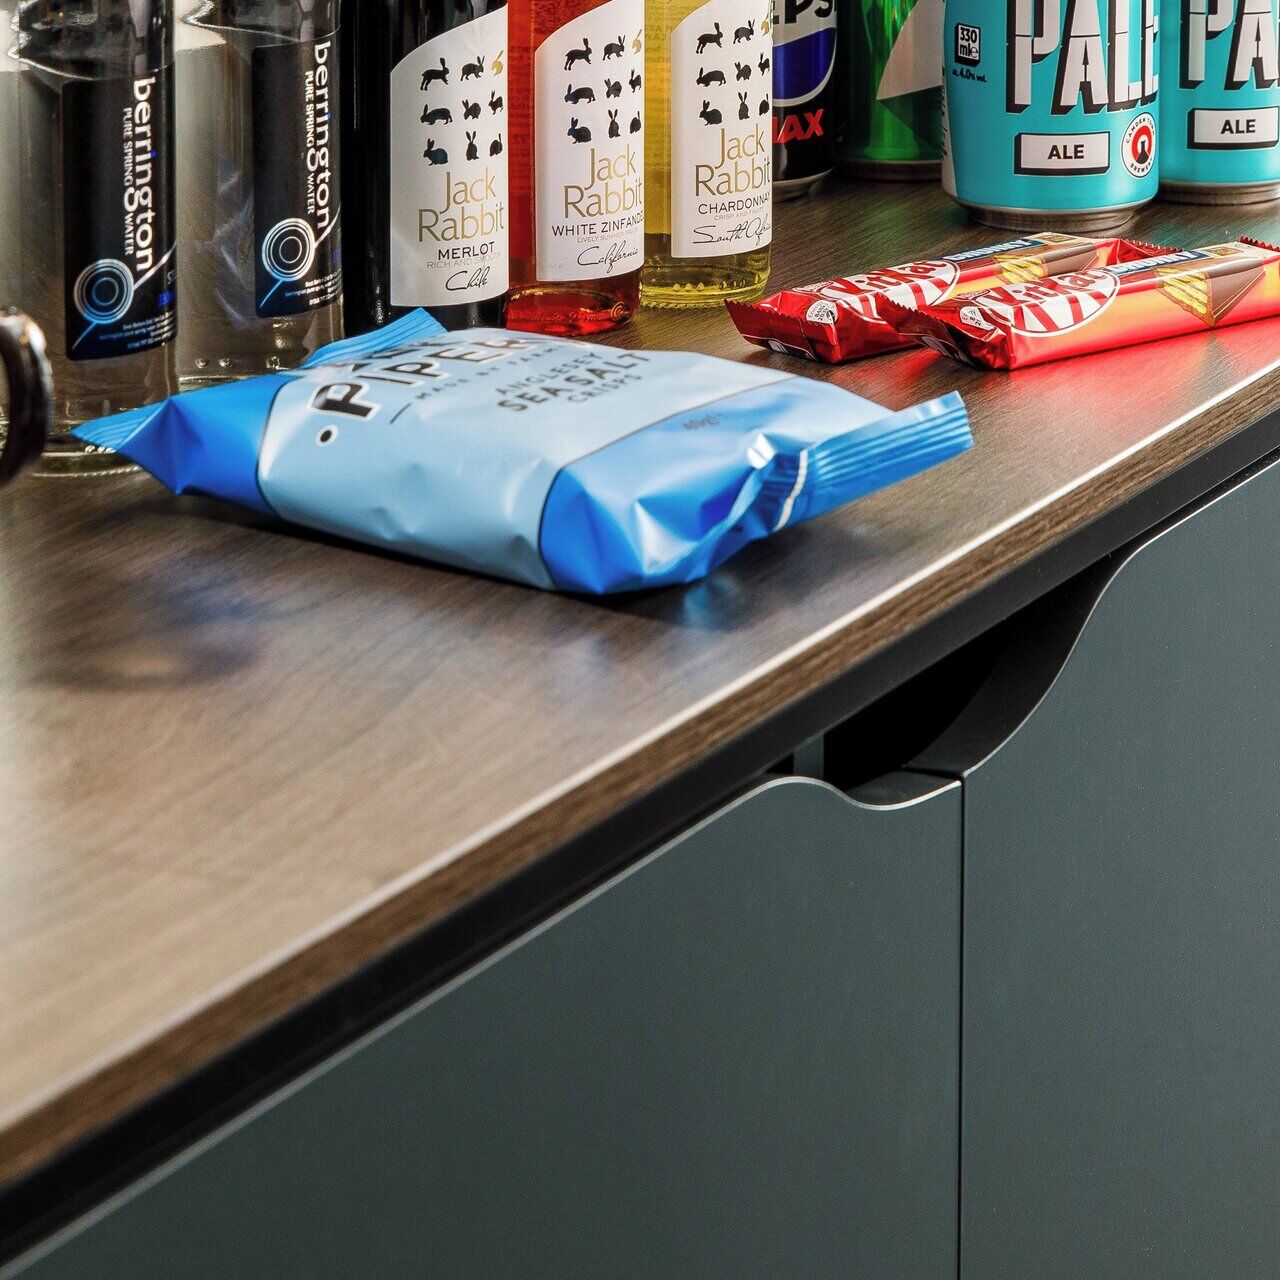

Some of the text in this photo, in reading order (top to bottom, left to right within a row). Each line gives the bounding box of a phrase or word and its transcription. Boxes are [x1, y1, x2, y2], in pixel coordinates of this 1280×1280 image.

[959, 26, 978, 44] 330
[306, 71, 315, 215] PURE SPRING WATER
[307, 40, 331, 228] berrington
[1126, 117, 1146, 143] CAMDEN
[1221, 118, 1256, 134] ALE
[715, 122, 765, 169] Jack
[1047, 145, 1085, 160] ALE
[123, 107, 134, 256] PURE SPRING WATER
[124, 76, 156, 271] berrington
[584, 142, 637, 191] Jack
[695, 156, 771, 197] Rabbit
[440, 167, 496, 214] Jack
[564, 176, 642, 218] Rabbit
[698, 191, 771, 215] CHARDONNAY
[418, 202, 504, 242] Rabbit
[552, 223, 597, 237] WHITE
[426, 260, 450, 269] RICH
[453, 258, 471, 267] AND
[438, 241, 495, 260] MERLOT
[942, 238, 1032, 261] CHUNKY
[1109, 250, 1198, 274] CHUNKY
[826, 261, 947, 296] KitKat
[983, 271, 1107, 307] KitKat
[496, 352, 602, 396] ANGLESEY
[497, 352, 650, 412] SEA SALT
[568, 373, 642, 403] CRISPS
